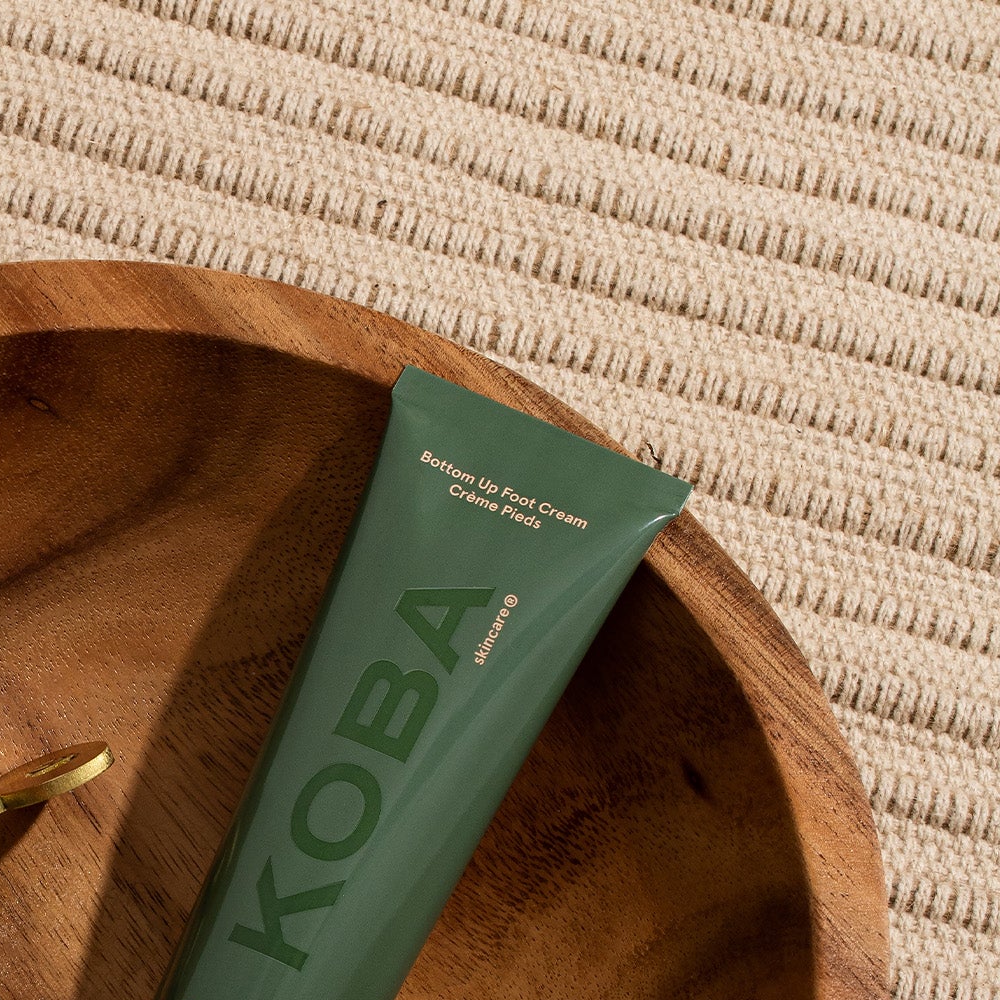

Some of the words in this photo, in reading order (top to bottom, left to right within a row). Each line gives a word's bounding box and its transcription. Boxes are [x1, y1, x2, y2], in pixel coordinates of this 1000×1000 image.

[420, 450, 475, 485] Bottom
[478, 477, 499, 496] Up
[501, 487, 537, 510] Foot
[539, 502, 588, 529] Cream
[449, 484, 499, 512] Crème
[501, 505, 542, 529] Pieds
[228, 586, 497, 973] KOBA
